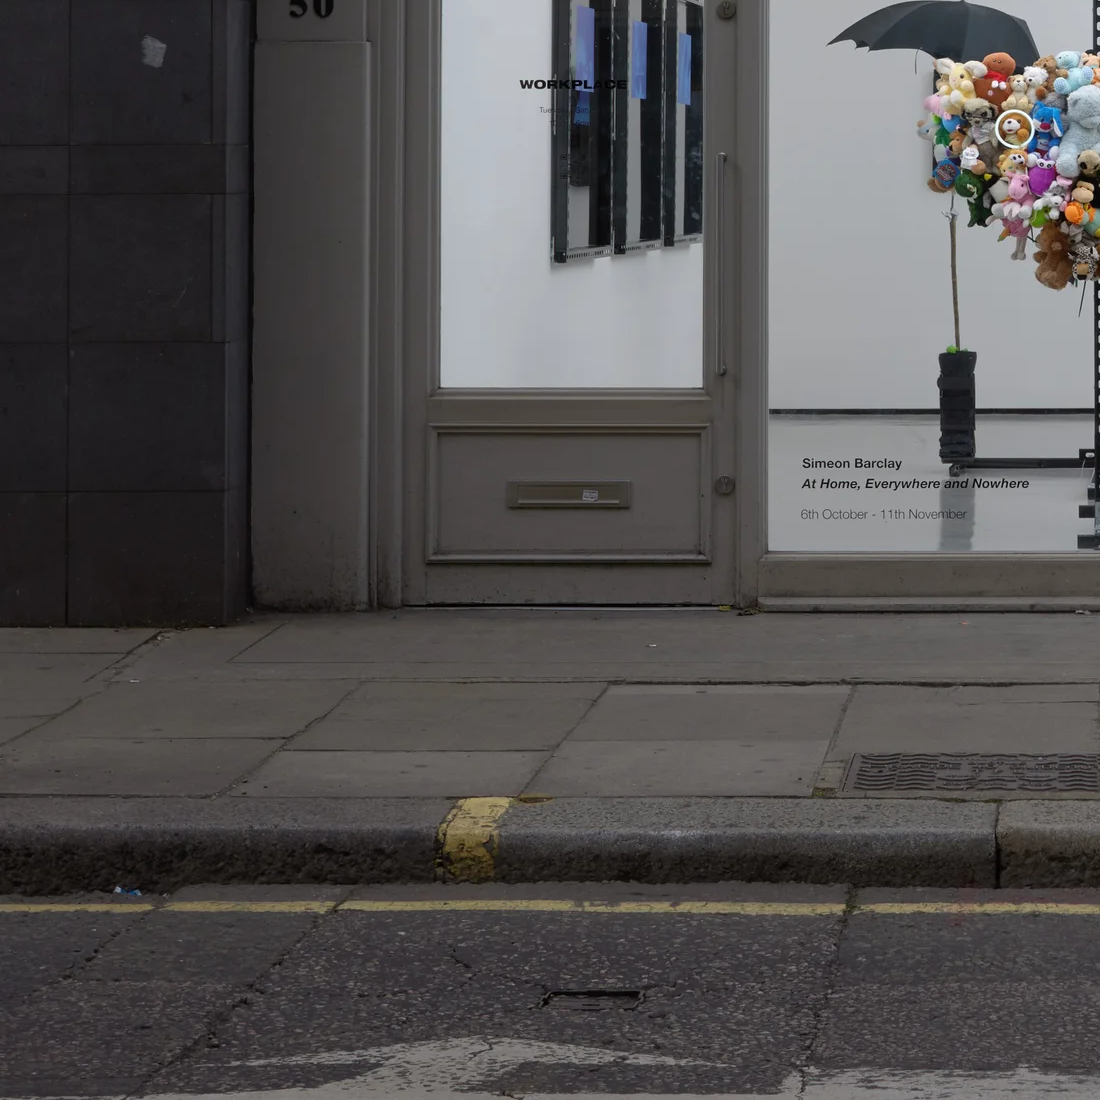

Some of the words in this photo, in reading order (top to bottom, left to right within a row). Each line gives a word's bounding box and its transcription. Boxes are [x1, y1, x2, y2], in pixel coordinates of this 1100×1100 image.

[519, 79, 628, 90] WORKPLACE
[802, 457, 851, 469] Simeon
[854, 457, 903, 471] Barclay
[801, 478, 817, 489] At
[820, 478, 861, 491] Home,
[865, 478, 941, 491] Everywhere
[943, 478, 970, 489] and
[971, 478, 1030, 489] Nowhere
[800, 508, 819, 520] 6th
[822, 508, 868, 520] October
[881, 508, 906, 520] 11th
[908, 508, 968, 520] November
